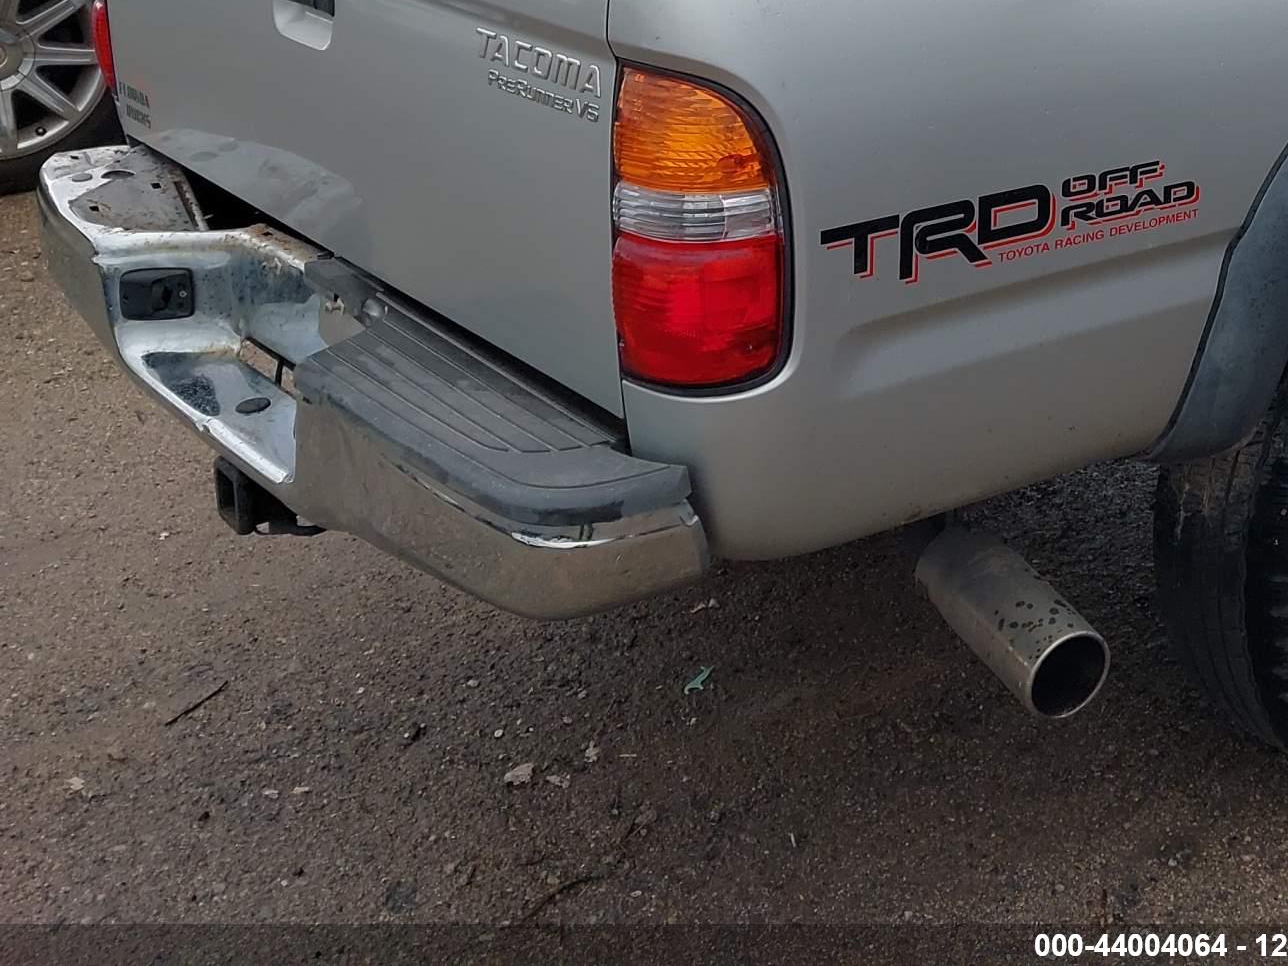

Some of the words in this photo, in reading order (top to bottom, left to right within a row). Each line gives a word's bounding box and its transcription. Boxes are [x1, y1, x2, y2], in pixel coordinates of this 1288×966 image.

[476, 27, 601, 98] TACOMA
[1060, 180, 1200, 231] ROAD
[1061, 160, 1165, 202] OFF
[820, 184, 1057, 284] TRD
[998, 241, 1050, 263] TOYOTA
[1055, 230, 1104, 250] RACING
[1109, 208, 1199, 237] DEVELOPMENT
